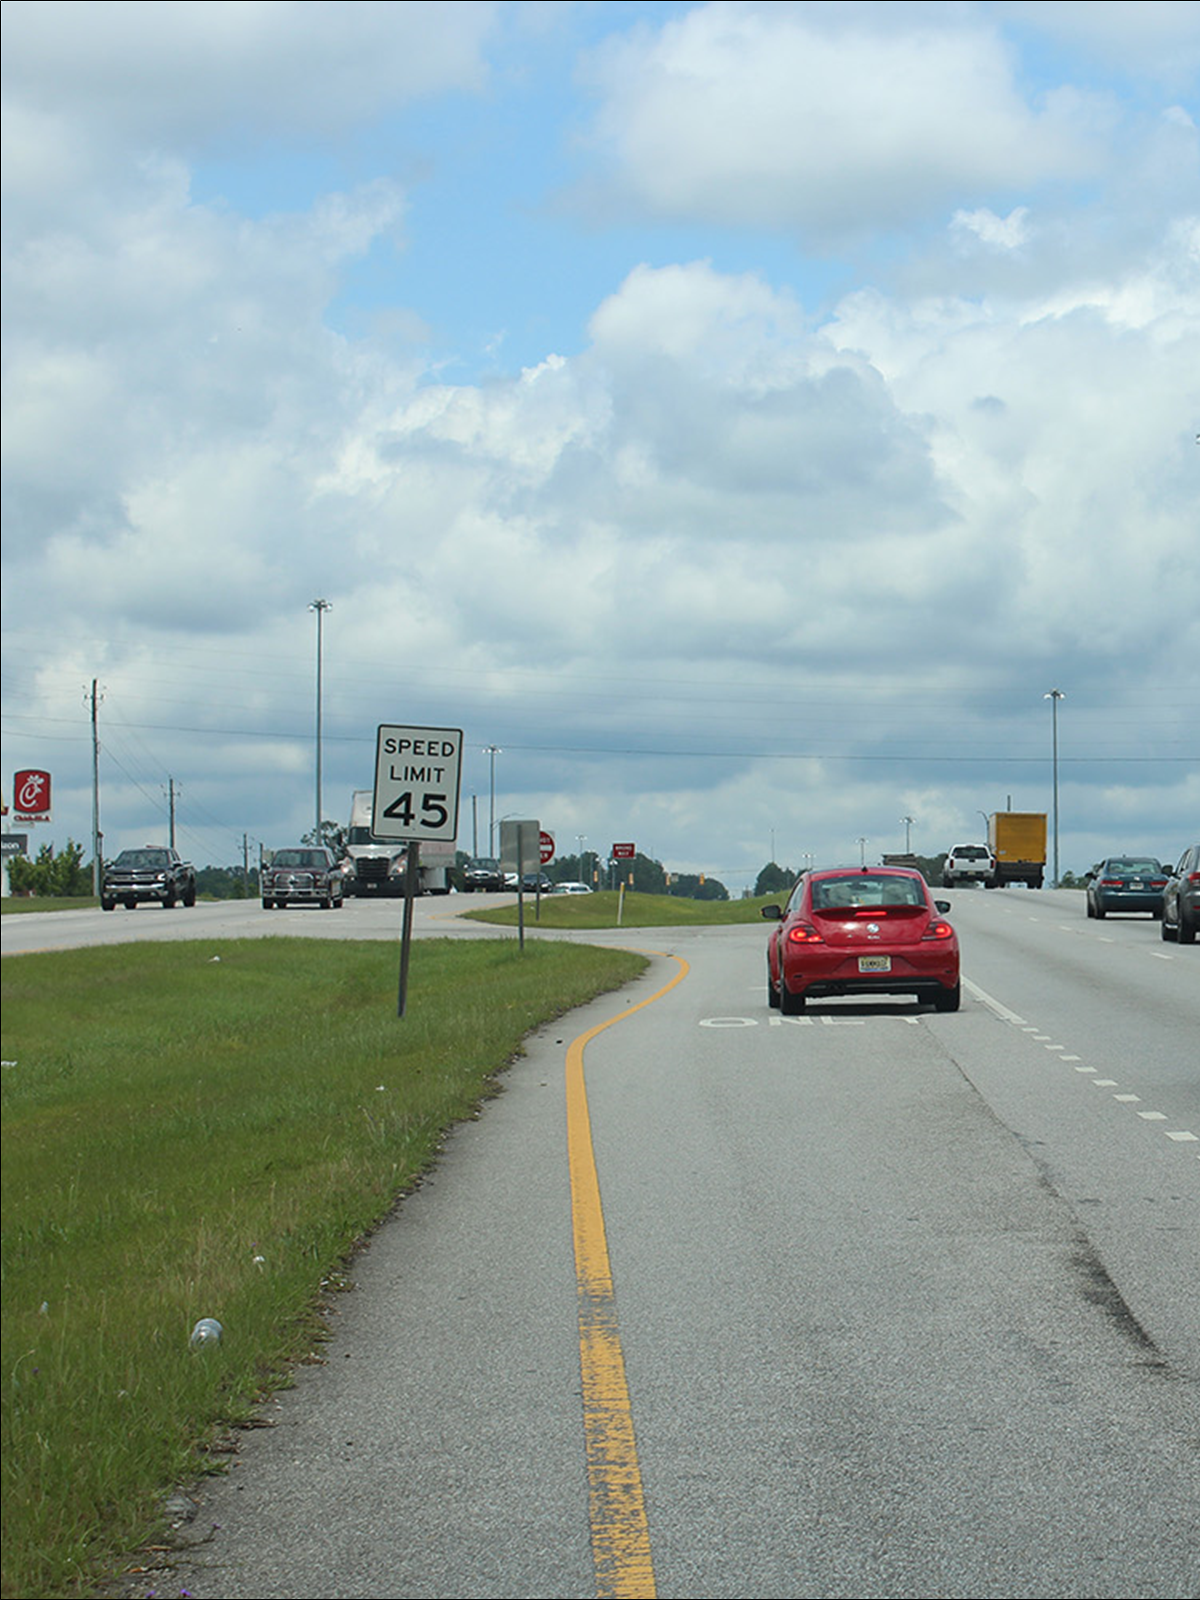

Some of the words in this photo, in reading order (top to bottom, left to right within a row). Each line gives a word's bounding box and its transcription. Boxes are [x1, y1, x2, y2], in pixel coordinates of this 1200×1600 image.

[384, 738, 454, 757] SPEED
[390, 765, 445, 783] LIMIT
[383, 792, 448, 828] 45
